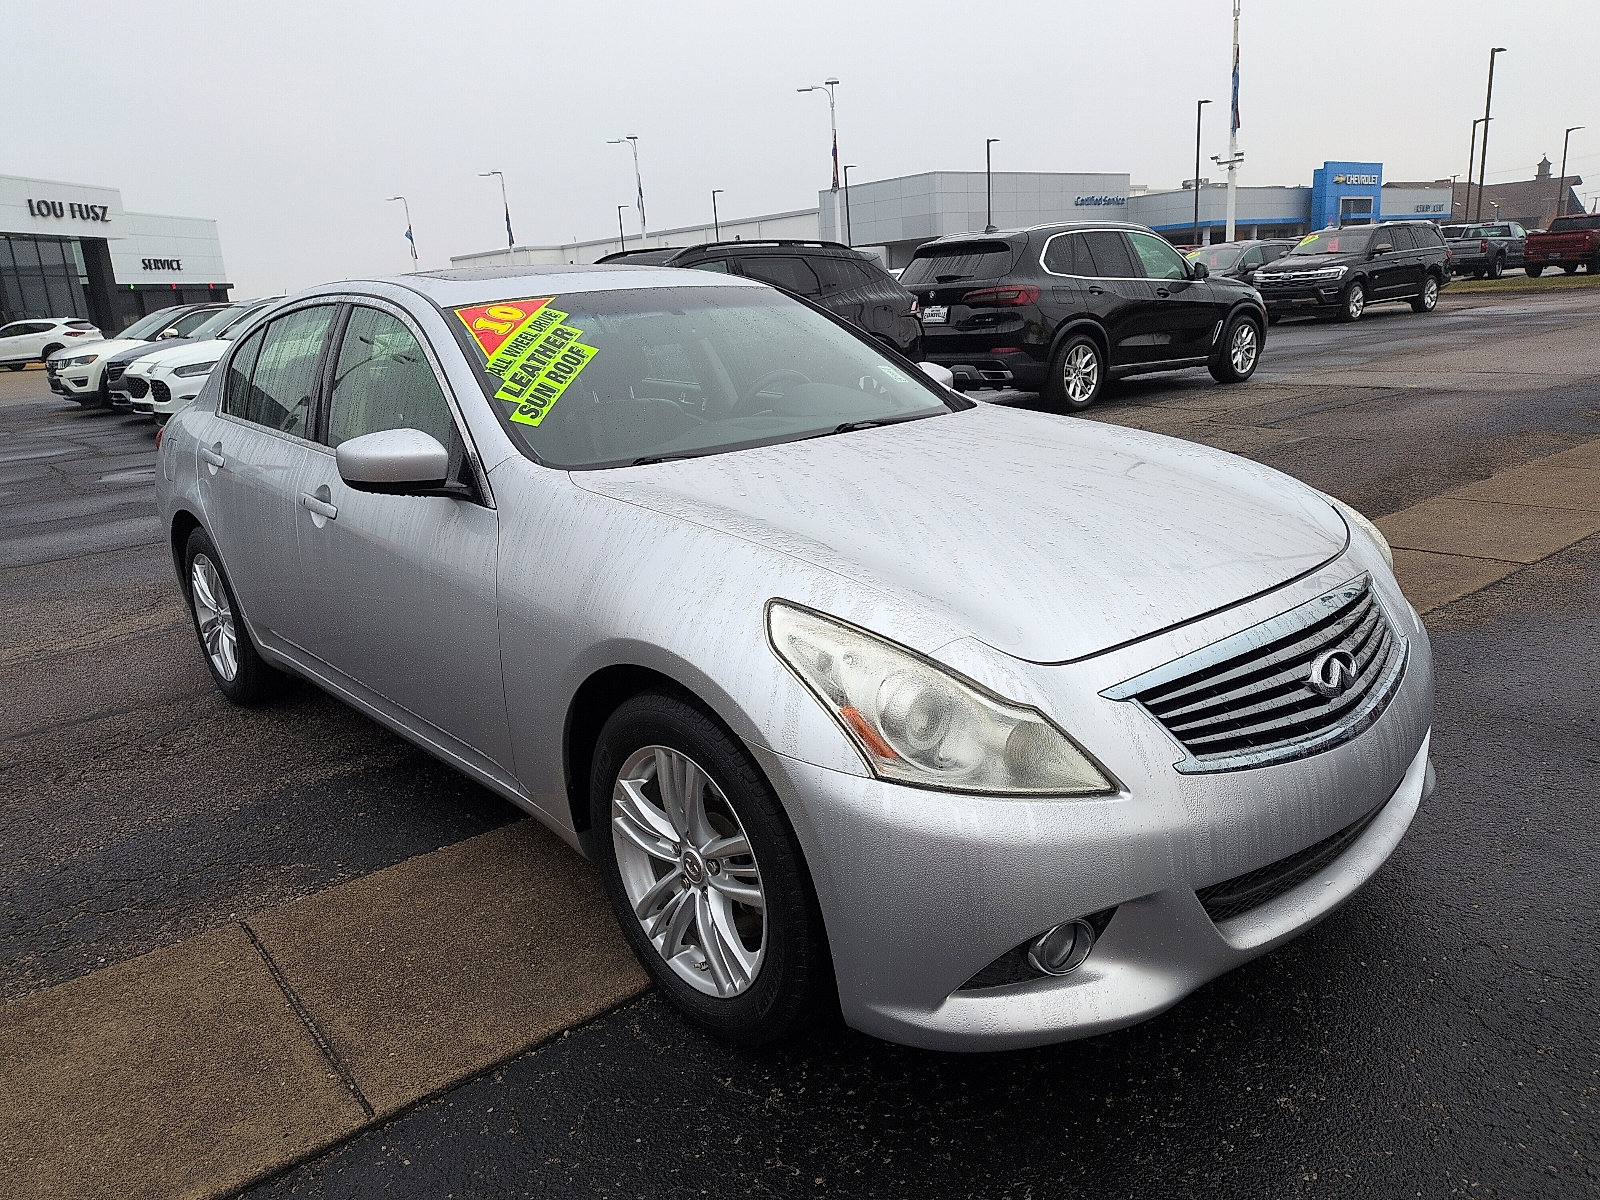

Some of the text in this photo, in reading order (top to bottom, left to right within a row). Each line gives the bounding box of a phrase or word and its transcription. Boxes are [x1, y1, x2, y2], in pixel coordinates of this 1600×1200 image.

[1346, 174, 1378, 185] CHEVROLET
[27, 198, 111, 222] LOU FUSZ
[1075, 195, 1125, 206] Certified Service
[141, 258, 183, 271] SERVICE
[473, 305, 526, 335] 10
[487, 309, 562, 377] ALL WHEEL DRIVE
[500, 327, 575, 399] LEATHER
[518, 345, 588, 420] SUN ROOF
